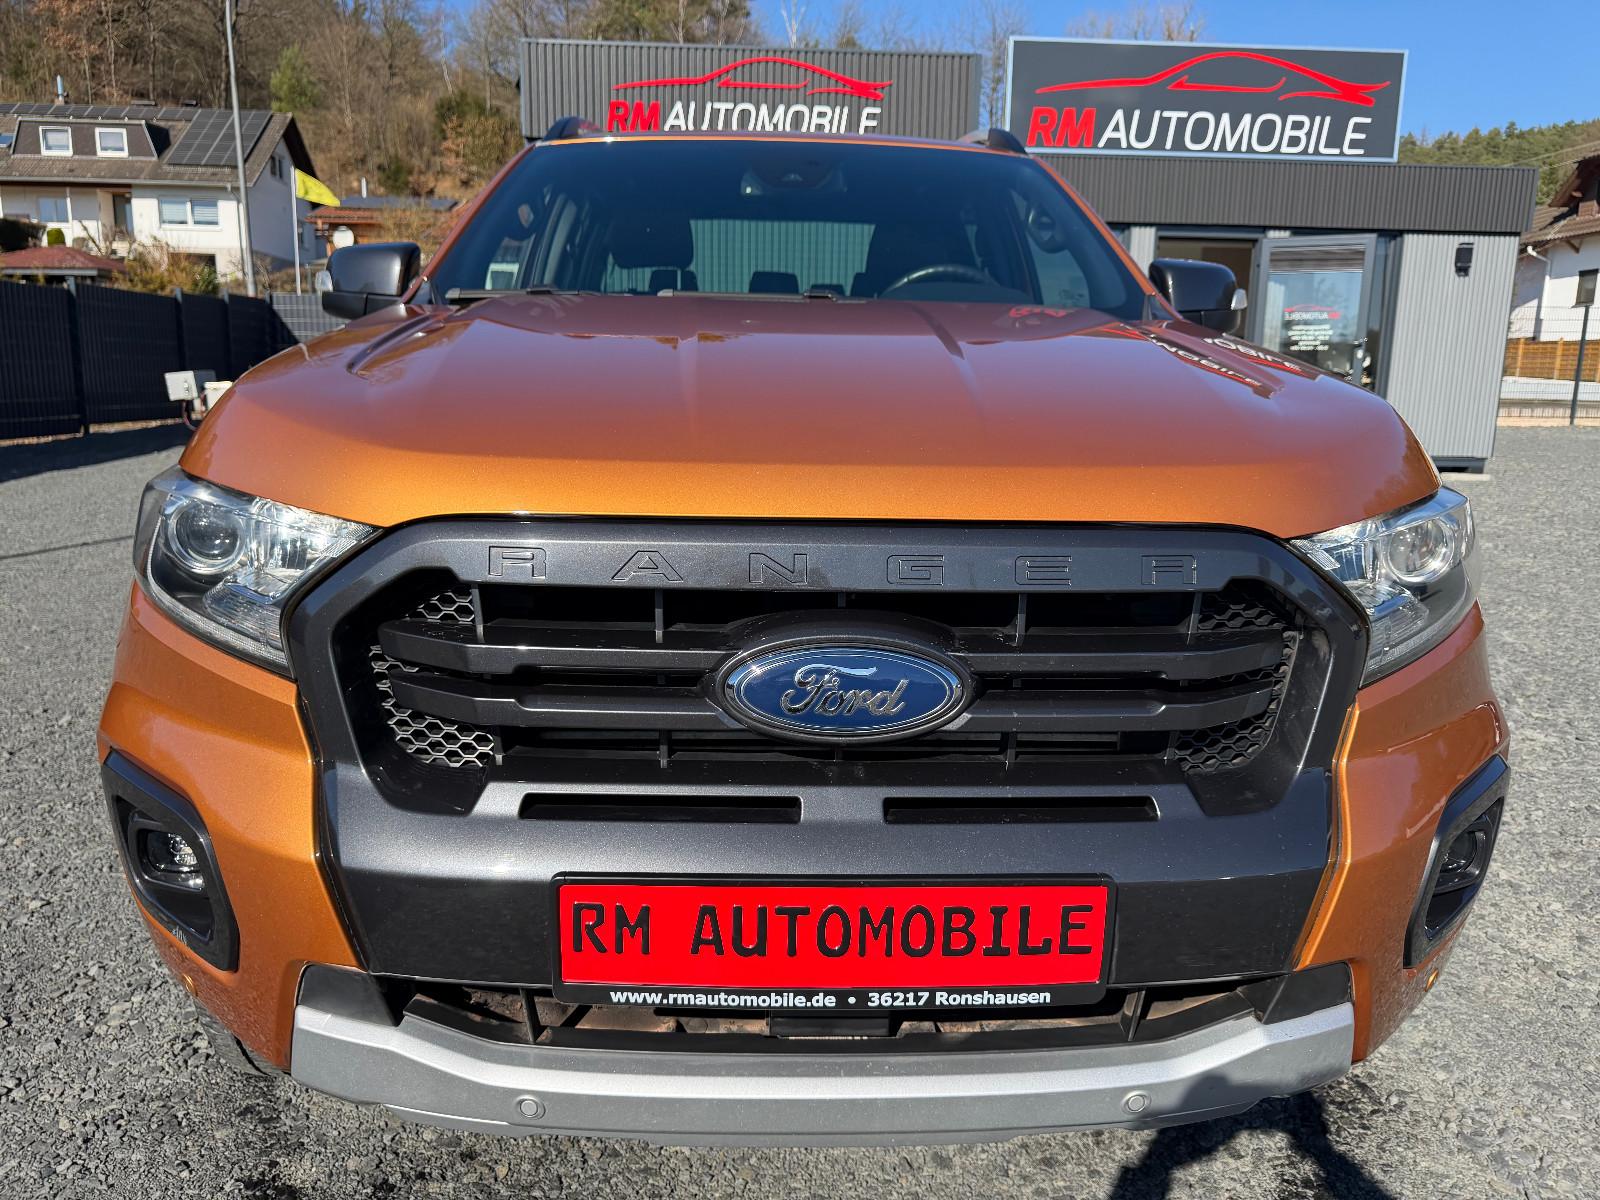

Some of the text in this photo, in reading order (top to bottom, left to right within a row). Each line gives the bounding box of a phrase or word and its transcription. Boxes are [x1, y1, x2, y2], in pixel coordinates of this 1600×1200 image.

[607, 100, 661, 132] RM
[1026, 107, 1373, 155] RM AUTOMOBILE
[488, 545, 1197, 586] RANGER
[780, 662, 910, 717] Ford
[572, 901, 1094, 958] RM AUTOMOBILE
[609, 989, 1051, 1008] www.rmautomobile.de 36217 Ronshausen
